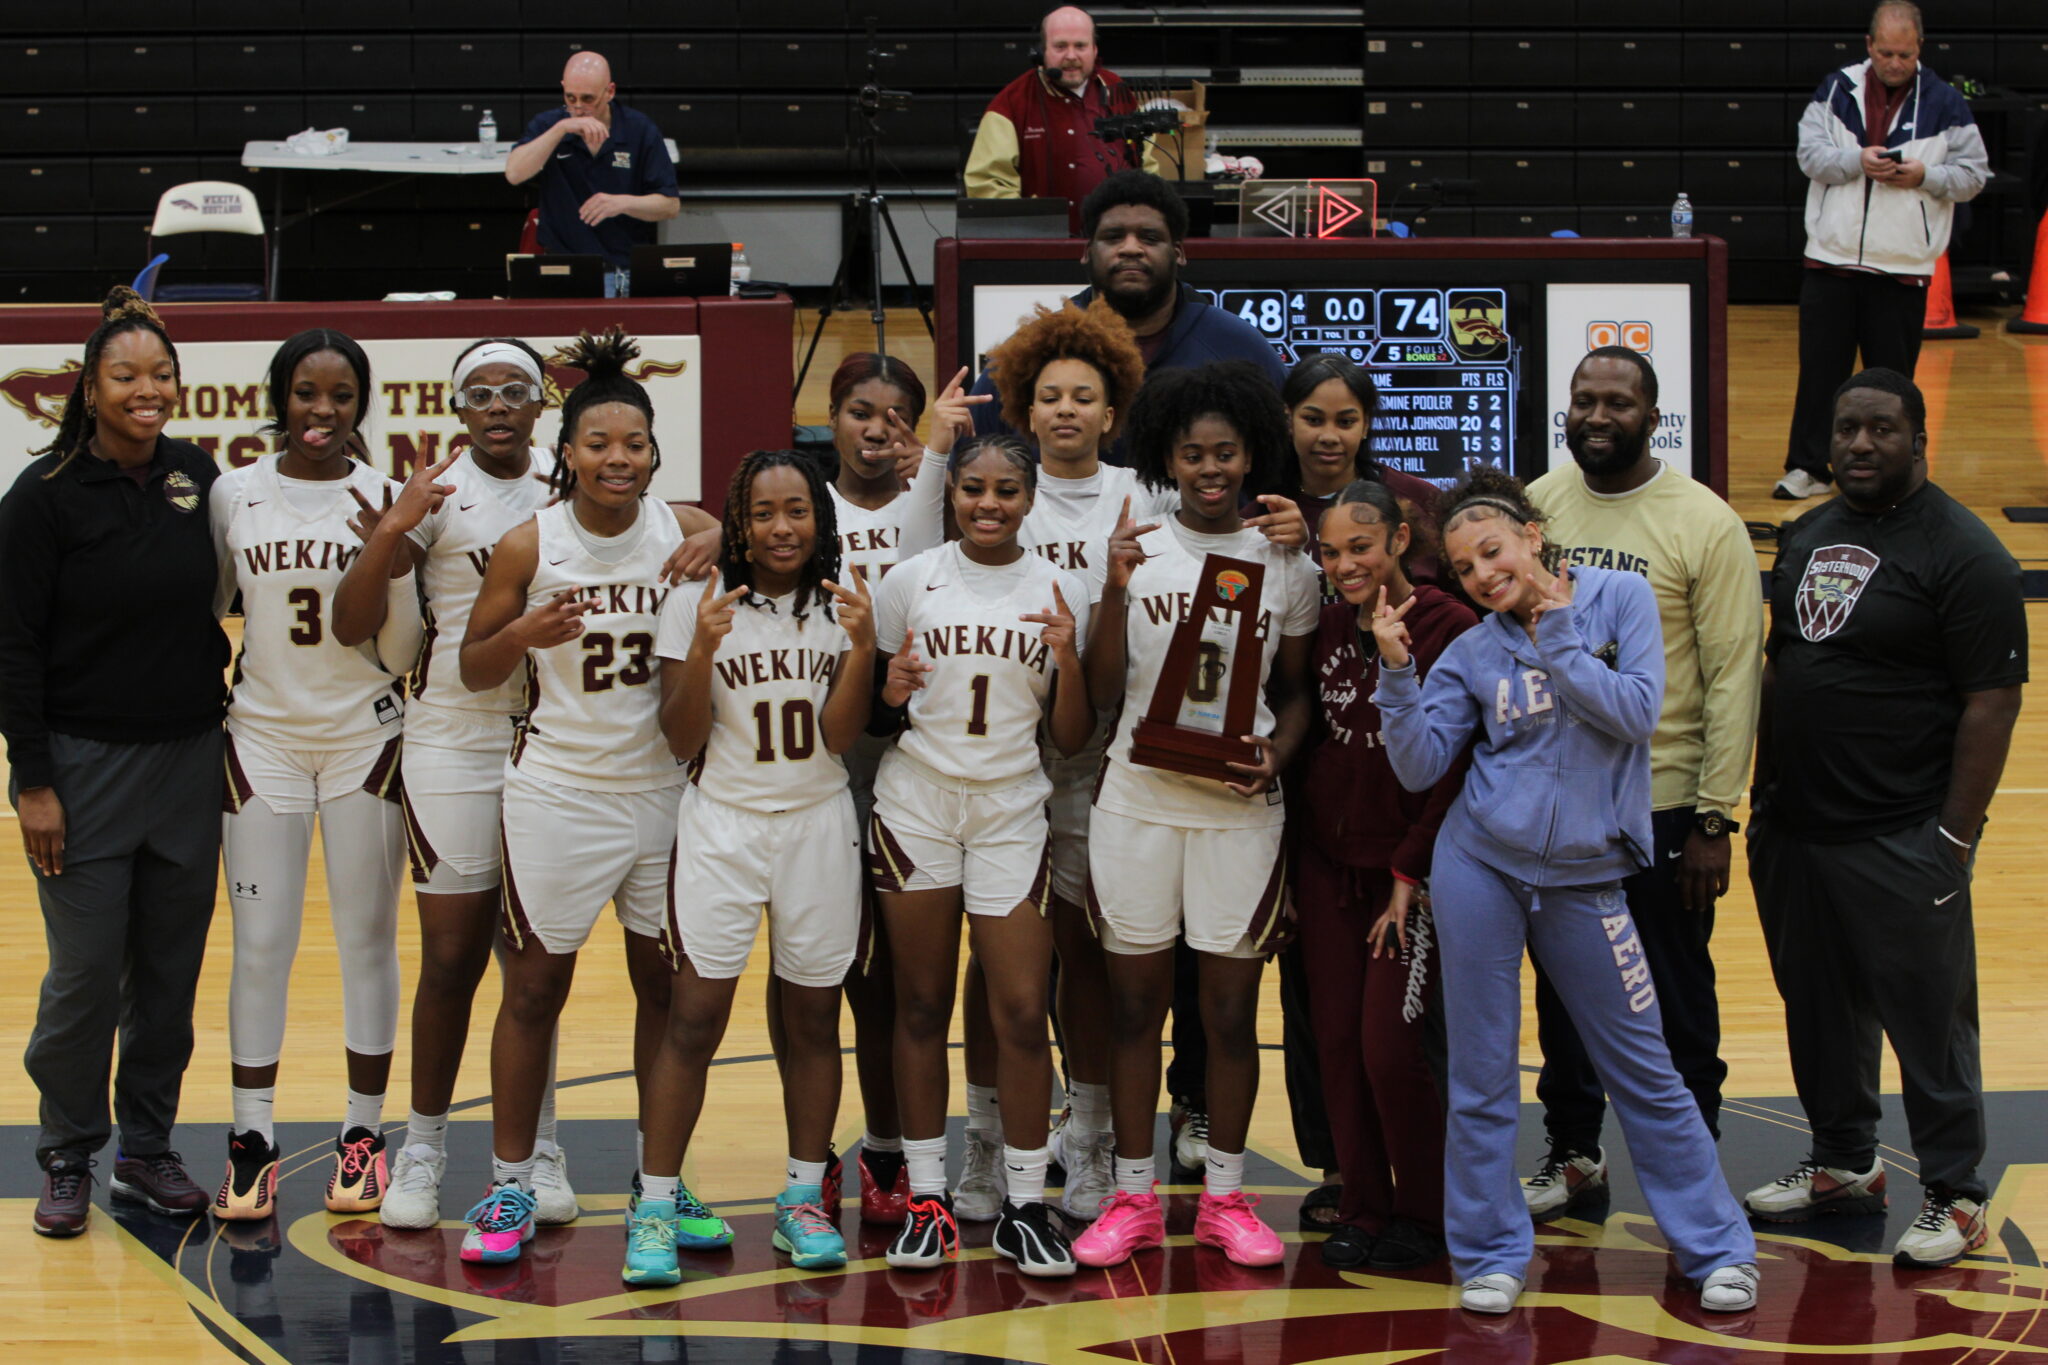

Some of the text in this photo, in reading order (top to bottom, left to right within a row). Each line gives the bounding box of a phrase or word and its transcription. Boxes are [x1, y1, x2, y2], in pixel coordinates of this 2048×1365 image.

[1290, 294, 1305, 310] 4
[1324, 297, 1365, 321] 0.0
[1394, 297, 1440, 331] 74
[1388, 346, 1401, 360] 5
[1405, 353, 1436, 361] BONUS
[1406, 345, 1443, 354] FOULS
[1369, 372, 1504, 387] AME PTS FLS
[170, 381, 461, 420] HOM TH
[1412, 395, 1453, 410] POOLER
[1467, 395, 1479, 411] 5
[1489, 395, 1501, 410] 2
[1410, 416, 1458, 430] JOHNSON
[1460, 415, 1482, 431] 20
[1489, 415, 1502, 431] 4
[1414, 436, 1439, 451] BELL
[1461, 436, 1482, 452] 15
[1490, 436, 1501, 451] 3
[1403, 457, 1426, 472] HILL
[243, 539, 361, 576] WEKIV
[1808, 560, 1869, 582] SISTERHOOD
[287, 585, 323, 648] 3
[580, 630, 655, 694] 23
[923, 624, 1050, 676] WEKIVA
[714, 648, 837, 690] WEKIVA
[964, 672, 992, 738] 1
[752, 697, 816, 764] 10
[1601, 913, 1656, 1013] AERO
